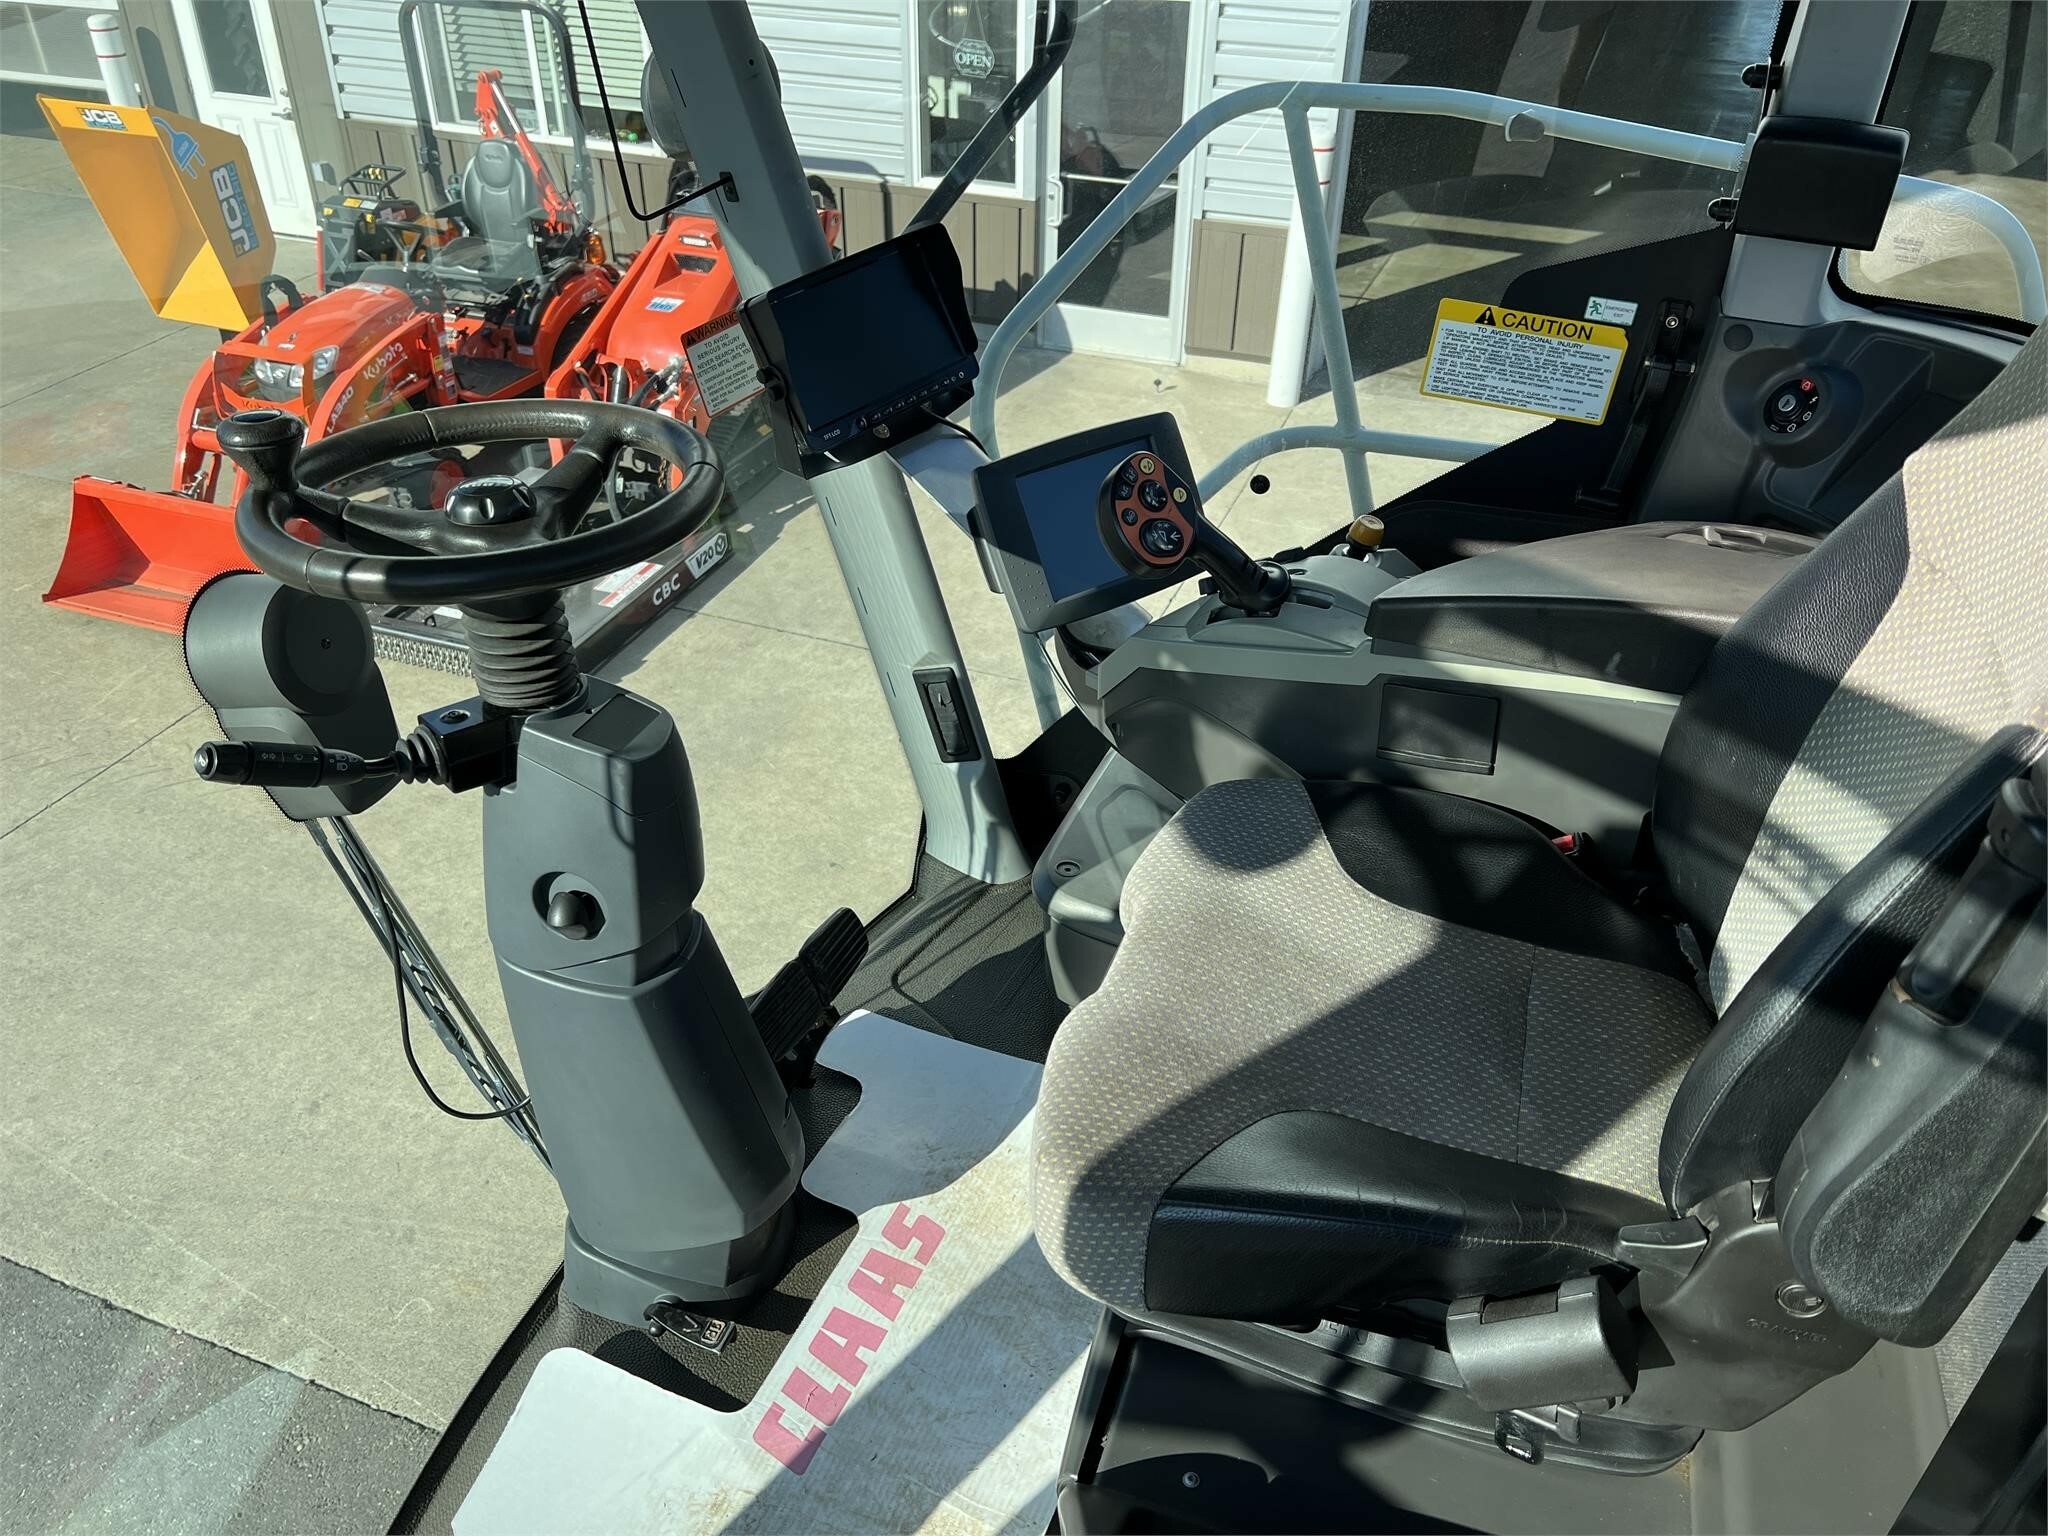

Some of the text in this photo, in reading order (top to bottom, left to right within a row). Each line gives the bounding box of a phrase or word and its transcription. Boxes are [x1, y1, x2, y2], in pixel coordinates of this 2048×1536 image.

[955, 52, 992, 68] OPEN
[82, 108, 122, 125] JCB
[212, 166, 251, 252] JCB
[226, 161, 259, 249] ELECTRIC
[1605, 304, 1634, 314] EMERGENCY
[694, 310, 738, 339] WARNING
[1502, 312, 1593, 341] CAUTION
[697, 334, 740, 360] SERIOUS INJURY
[703, 332, 729, 349] TO AVOID
[1490, 330, 1512, 338] AVOID
[1515, 334, 1552, 346] PERSONAL
[1556, 341, 1584, 350] INJURY
[362, 341, 404, 380] Kubota
[697, 357, 714, 370] NEVER
[734, 341, 746, 351] FOR
[326, 386, 354, 434] LA340
[832, 428, 841, 438] LCD
[696, 546, 714, 570] V20
[652, 572, 681, 606] CBC
[753, 1201, 946, 1477] CLAAS
